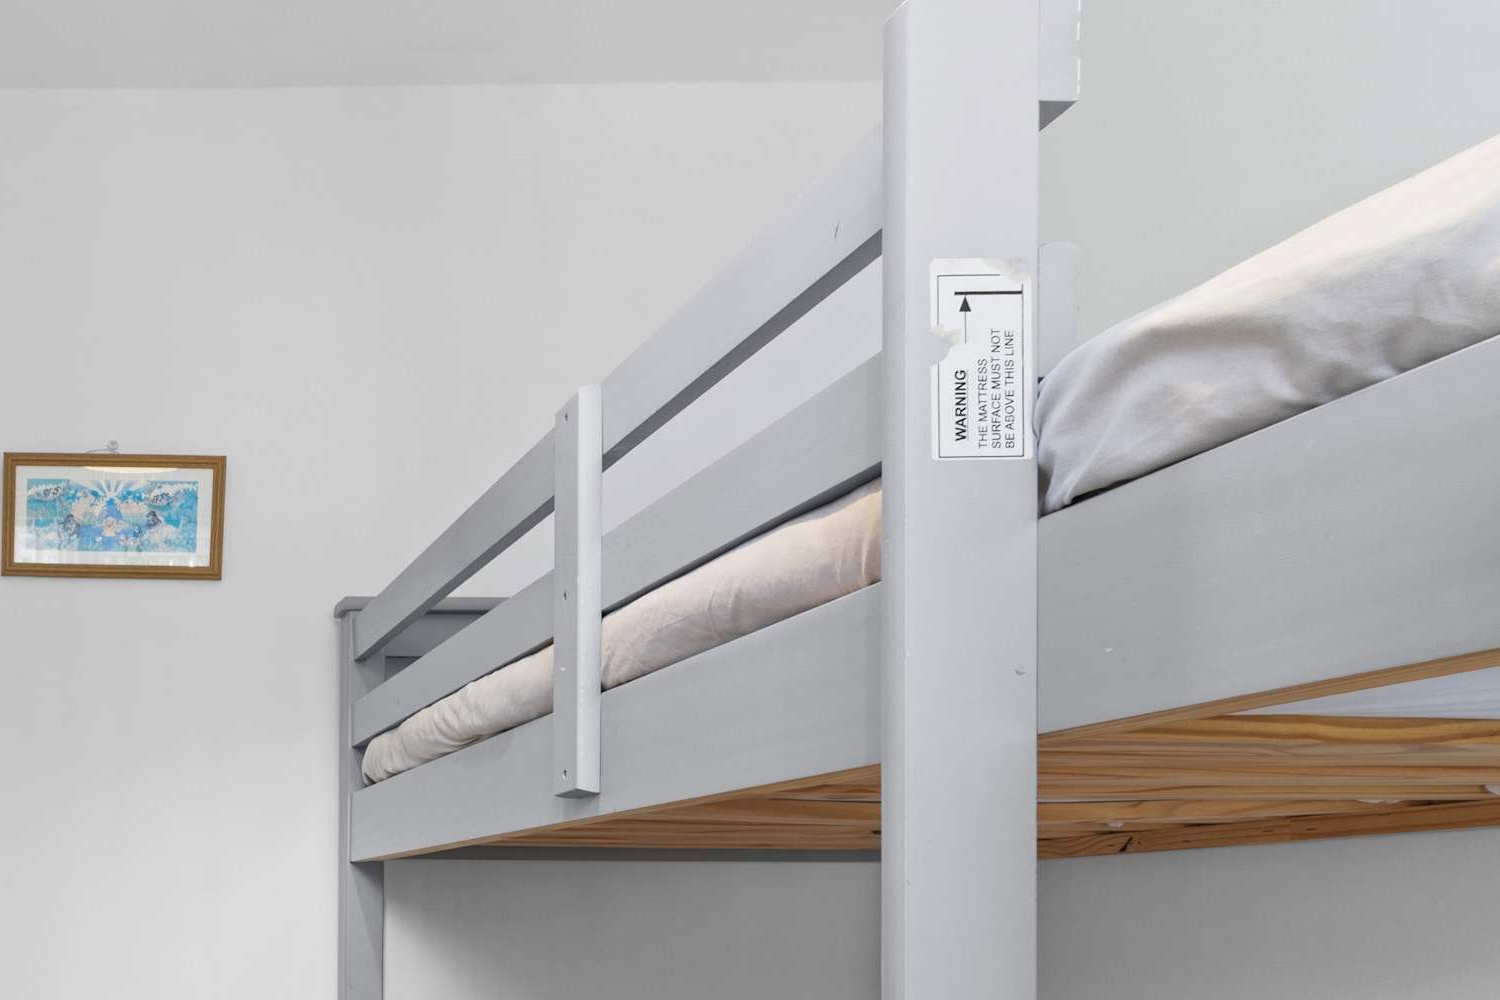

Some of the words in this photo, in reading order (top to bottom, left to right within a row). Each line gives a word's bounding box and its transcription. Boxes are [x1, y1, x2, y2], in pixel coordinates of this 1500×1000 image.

[991, 328, 1001, 353] NOT
[1004, 330, 1014, 356] LINE
[991, 357, 1001, 390] MUST
[1004, 359, 1014, 386] THIS
[978, 358, 988, 422] MATTRESS
[955, 370, 967, 442] WARNING
[1005, 390, 1015, 430] ABOVE
[991, 394, 1002, 449] SURFACE
[978, 426, 988, 448] THE
[1005, 433, 1015, 449] BE
